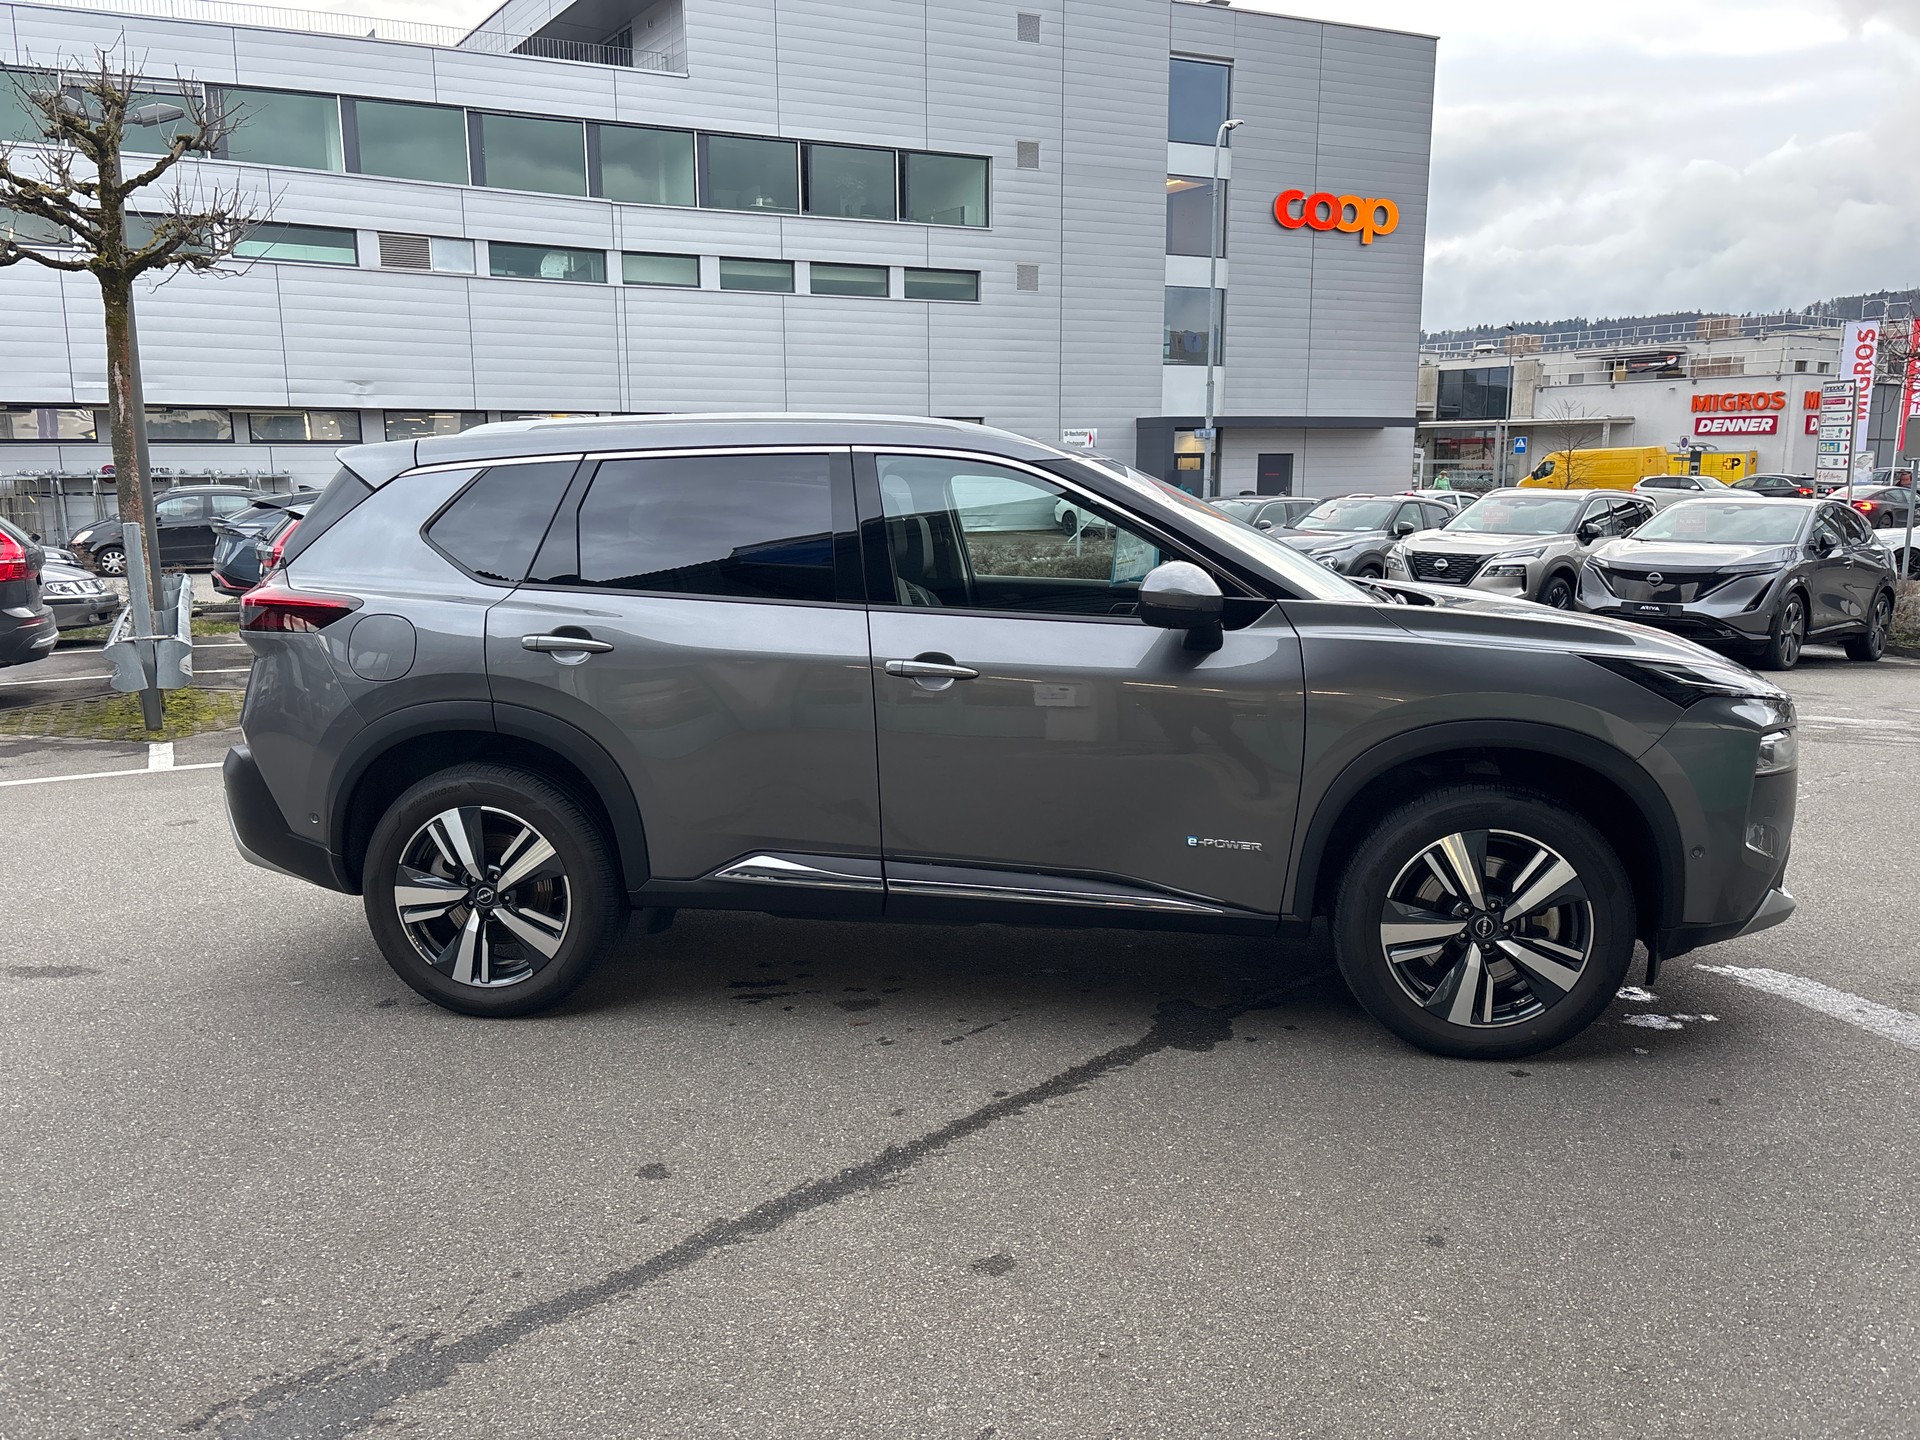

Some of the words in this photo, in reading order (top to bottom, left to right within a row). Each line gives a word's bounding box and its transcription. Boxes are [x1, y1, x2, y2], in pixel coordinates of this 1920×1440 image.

[1273, 189, 1399, 245] coop
[1691, 391, 1785, 412] MIGROS
[1698, 418, 1773, 433] DENNER
[1187, 838, 1262, 851] e-POWER
